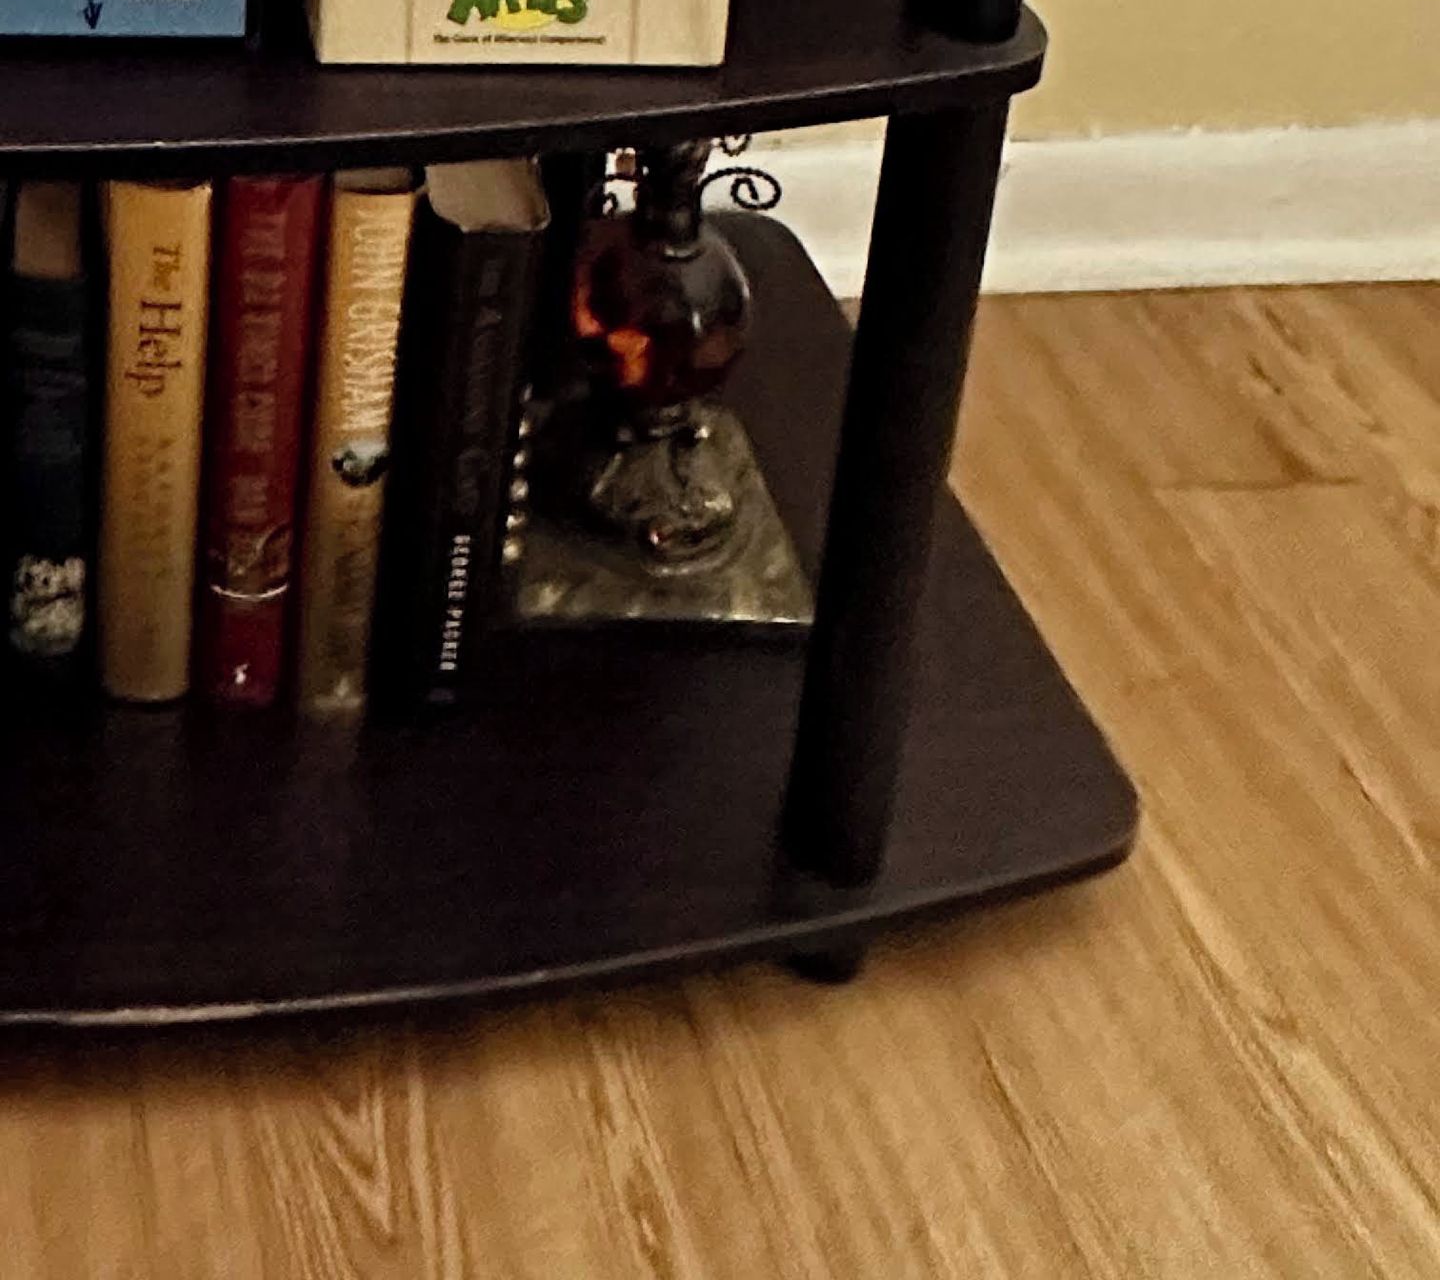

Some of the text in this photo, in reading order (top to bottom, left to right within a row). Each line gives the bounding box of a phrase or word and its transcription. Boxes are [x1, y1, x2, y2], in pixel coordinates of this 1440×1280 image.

[152, 243, 181, 291] The
[352, 207, 407, 290] JOHN
[124, 299, 183, 398] Help
[341, 300, 401, 431] GRISHAM
